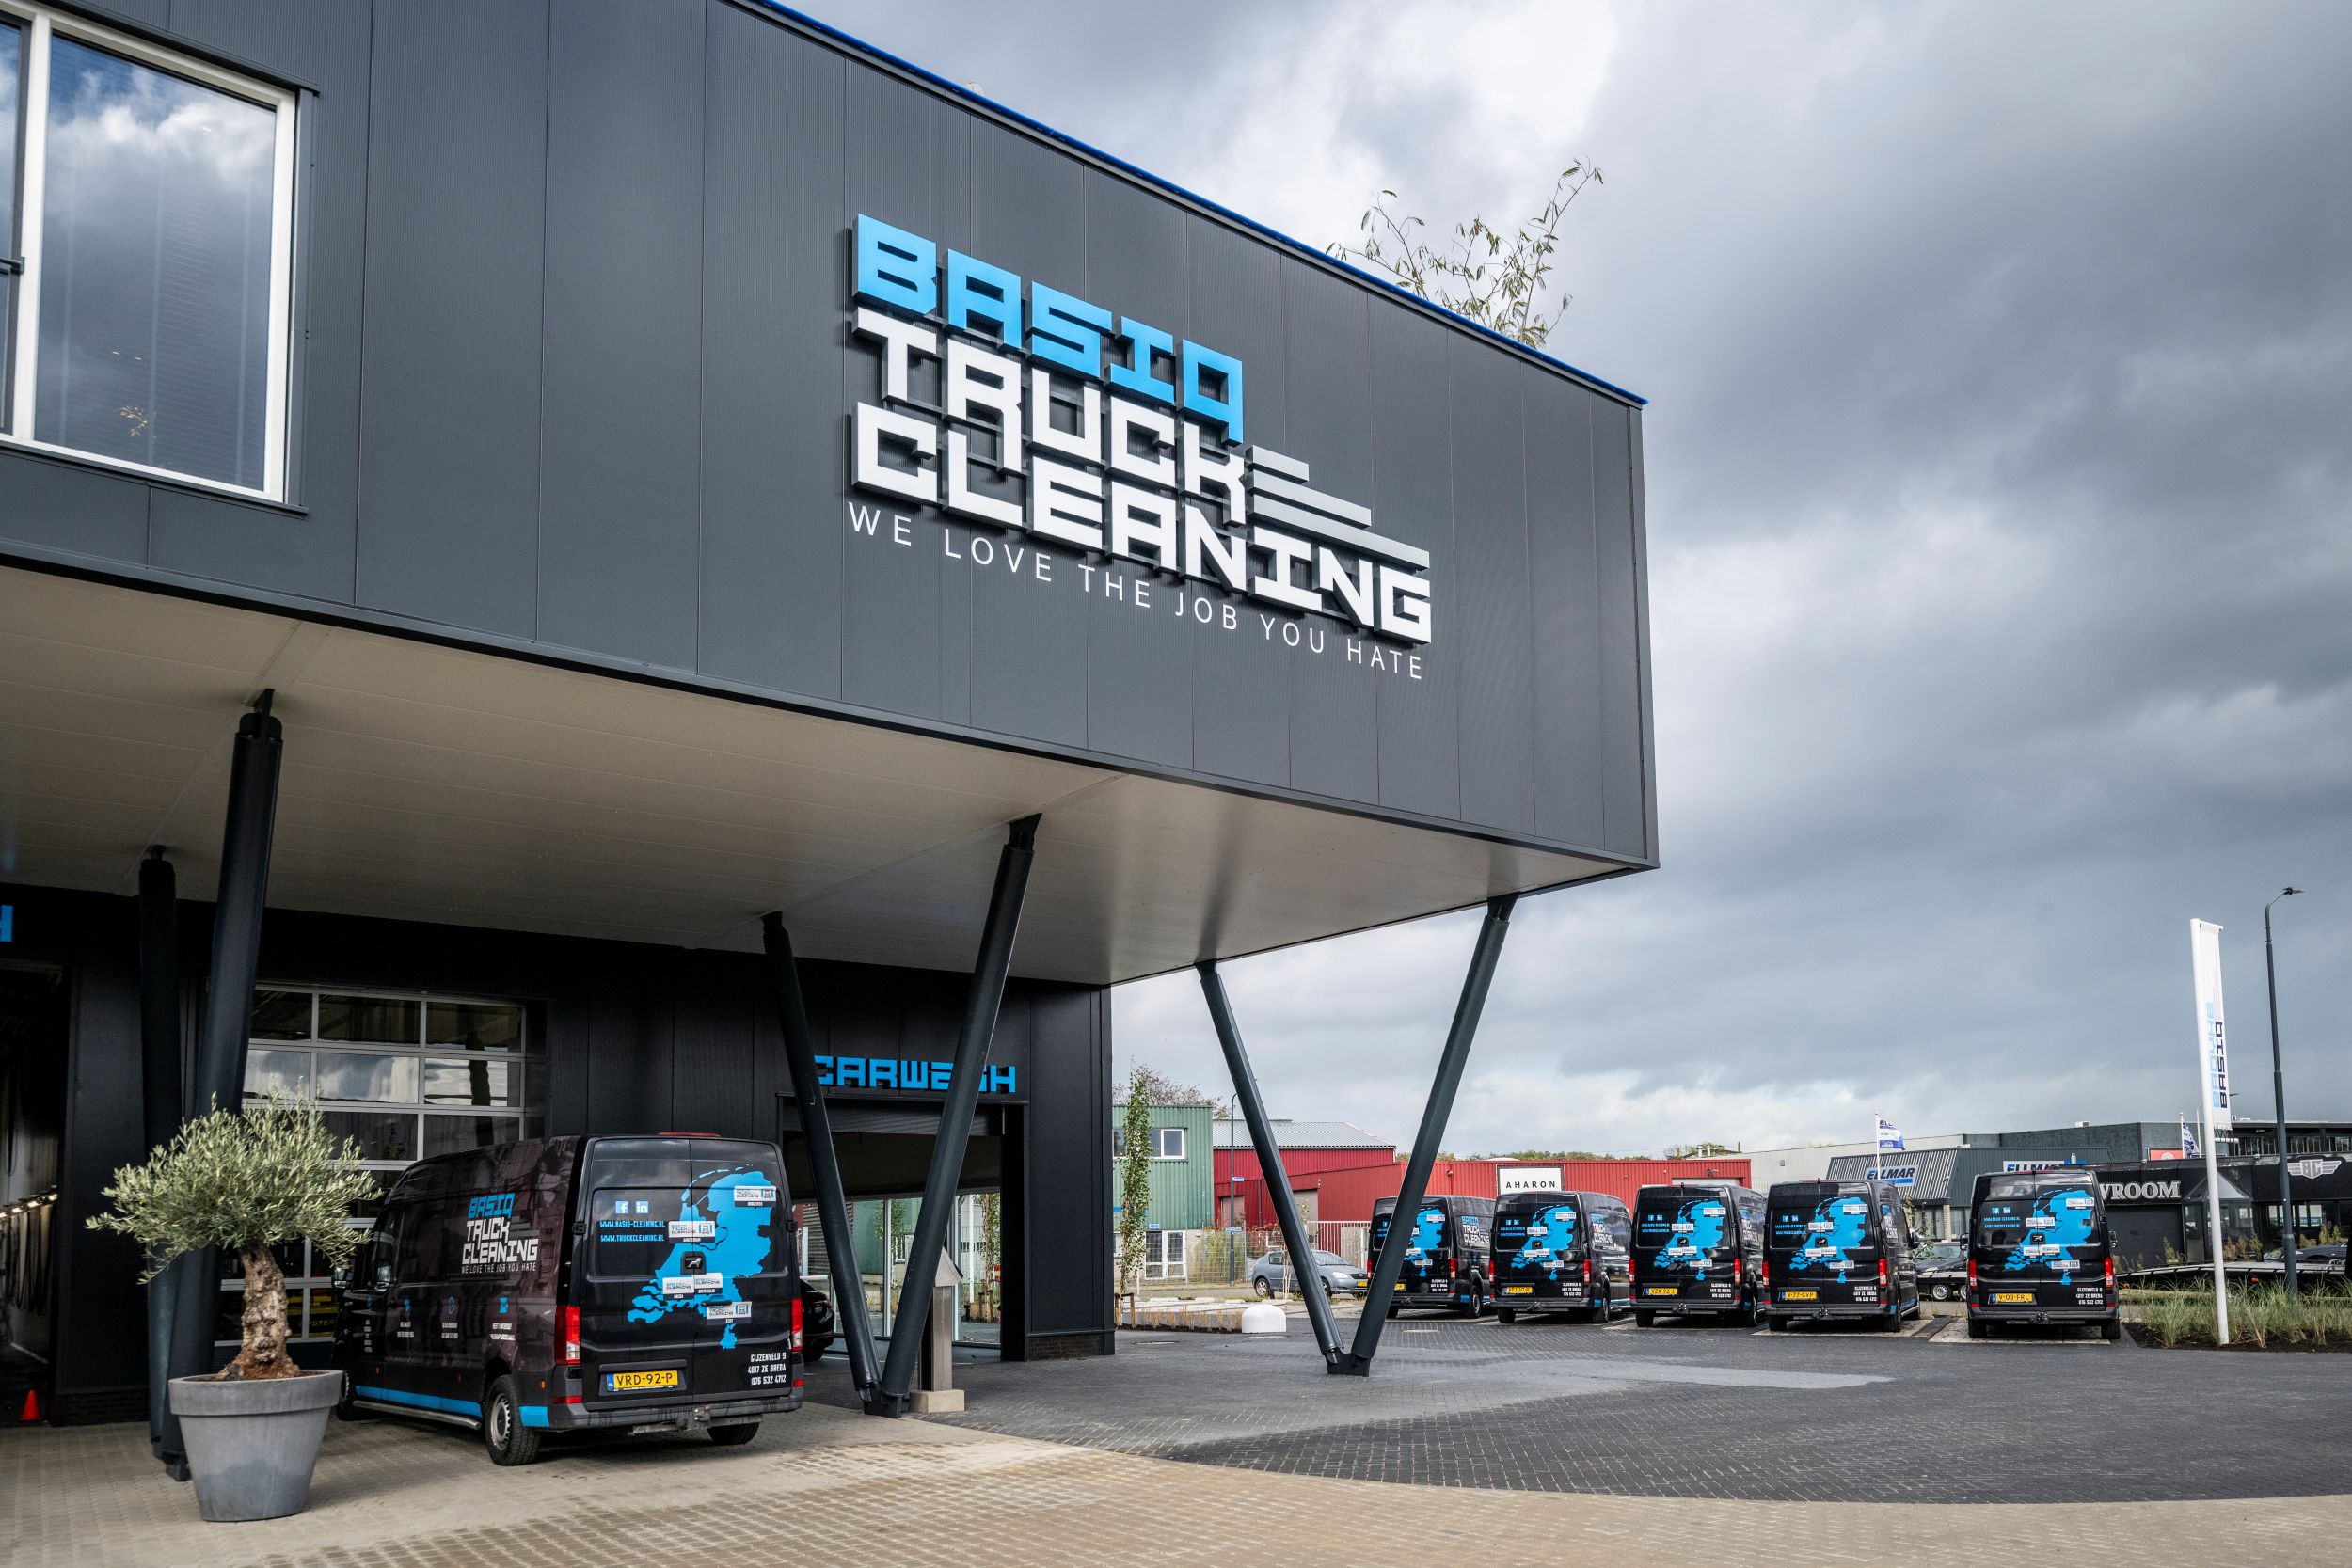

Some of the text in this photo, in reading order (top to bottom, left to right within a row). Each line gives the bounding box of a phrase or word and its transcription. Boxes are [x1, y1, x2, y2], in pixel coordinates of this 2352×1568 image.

[854, 213, 1243, 445] BASIQ
[853, 307, 1246, 525] TRUCK
[853, 402, 1431, 644] CLEANING
[849, 501, 1422, 680] WE LOVE THE JOB YOU HATE
[1505, 1180, 1555, 1189] AHARON
[468, 1193, 516, 1220] BASIQ
[466, 1217, 511, 1250] TRUCK
[461, 1238, 539, 1265] CLEANING
[469, 1264, 483, 1274] LOVE
[485, 1263, 495, 1273] THE
[496, 1263, 506, 1273] JOB
[508, 1262, 519, 1272] YOU
[521, 1261, 536, 1272] HATE
[770, 1363, 787, 1372] BREDA
[782, 1352, 787, 1360] 9
[616, 1372, 673, 1386] VRD-92-P
[751, 1376, 762, 1386] 076
[763, 1375, 773, 1385] 532
